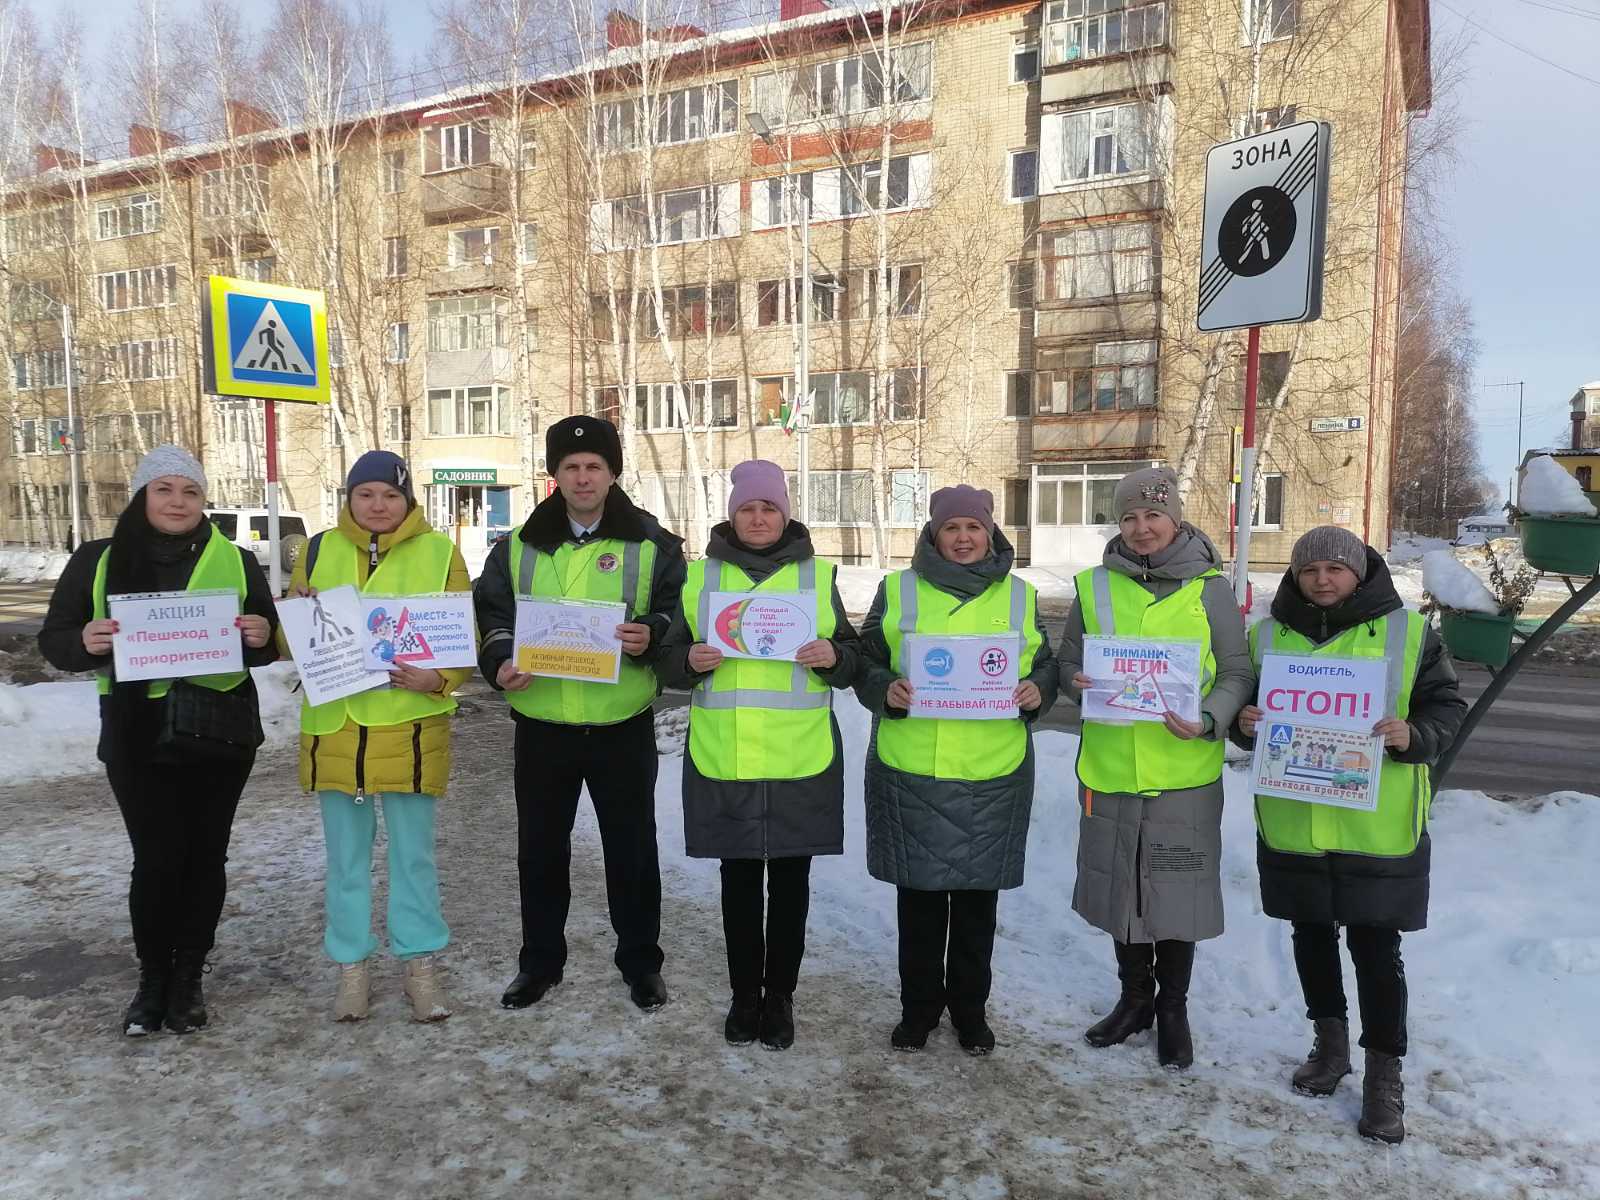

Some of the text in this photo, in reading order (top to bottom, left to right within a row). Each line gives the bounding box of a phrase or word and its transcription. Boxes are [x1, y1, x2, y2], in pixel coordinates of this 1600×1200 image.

[1231, 138, 1292, 170] ЗОНА
[1351, 419, 1358, 428] 8
[434, 471, 496, 481] САДОВНИК
[147, 605, 207, 621] АКЦИЯ
[409, 610, 447, 621] вместе
[126, 627, 230, 643] «Пешеход в
[427, 634, 469, 643] дорожного
[433, 644, 470, 654] движения
[128, 649, 230, 668] приоритете»
[1113, 658, 1168, 674] ДЕТИ!
[1288, 664, 1356, 678] ВОДИТЕЛЬ,
[920, 699, 934, 708] НЕ
[936, 698, 986, 709] ЗАБЫВАЙ
[1266, 688, 1371, 718] СТОП!
